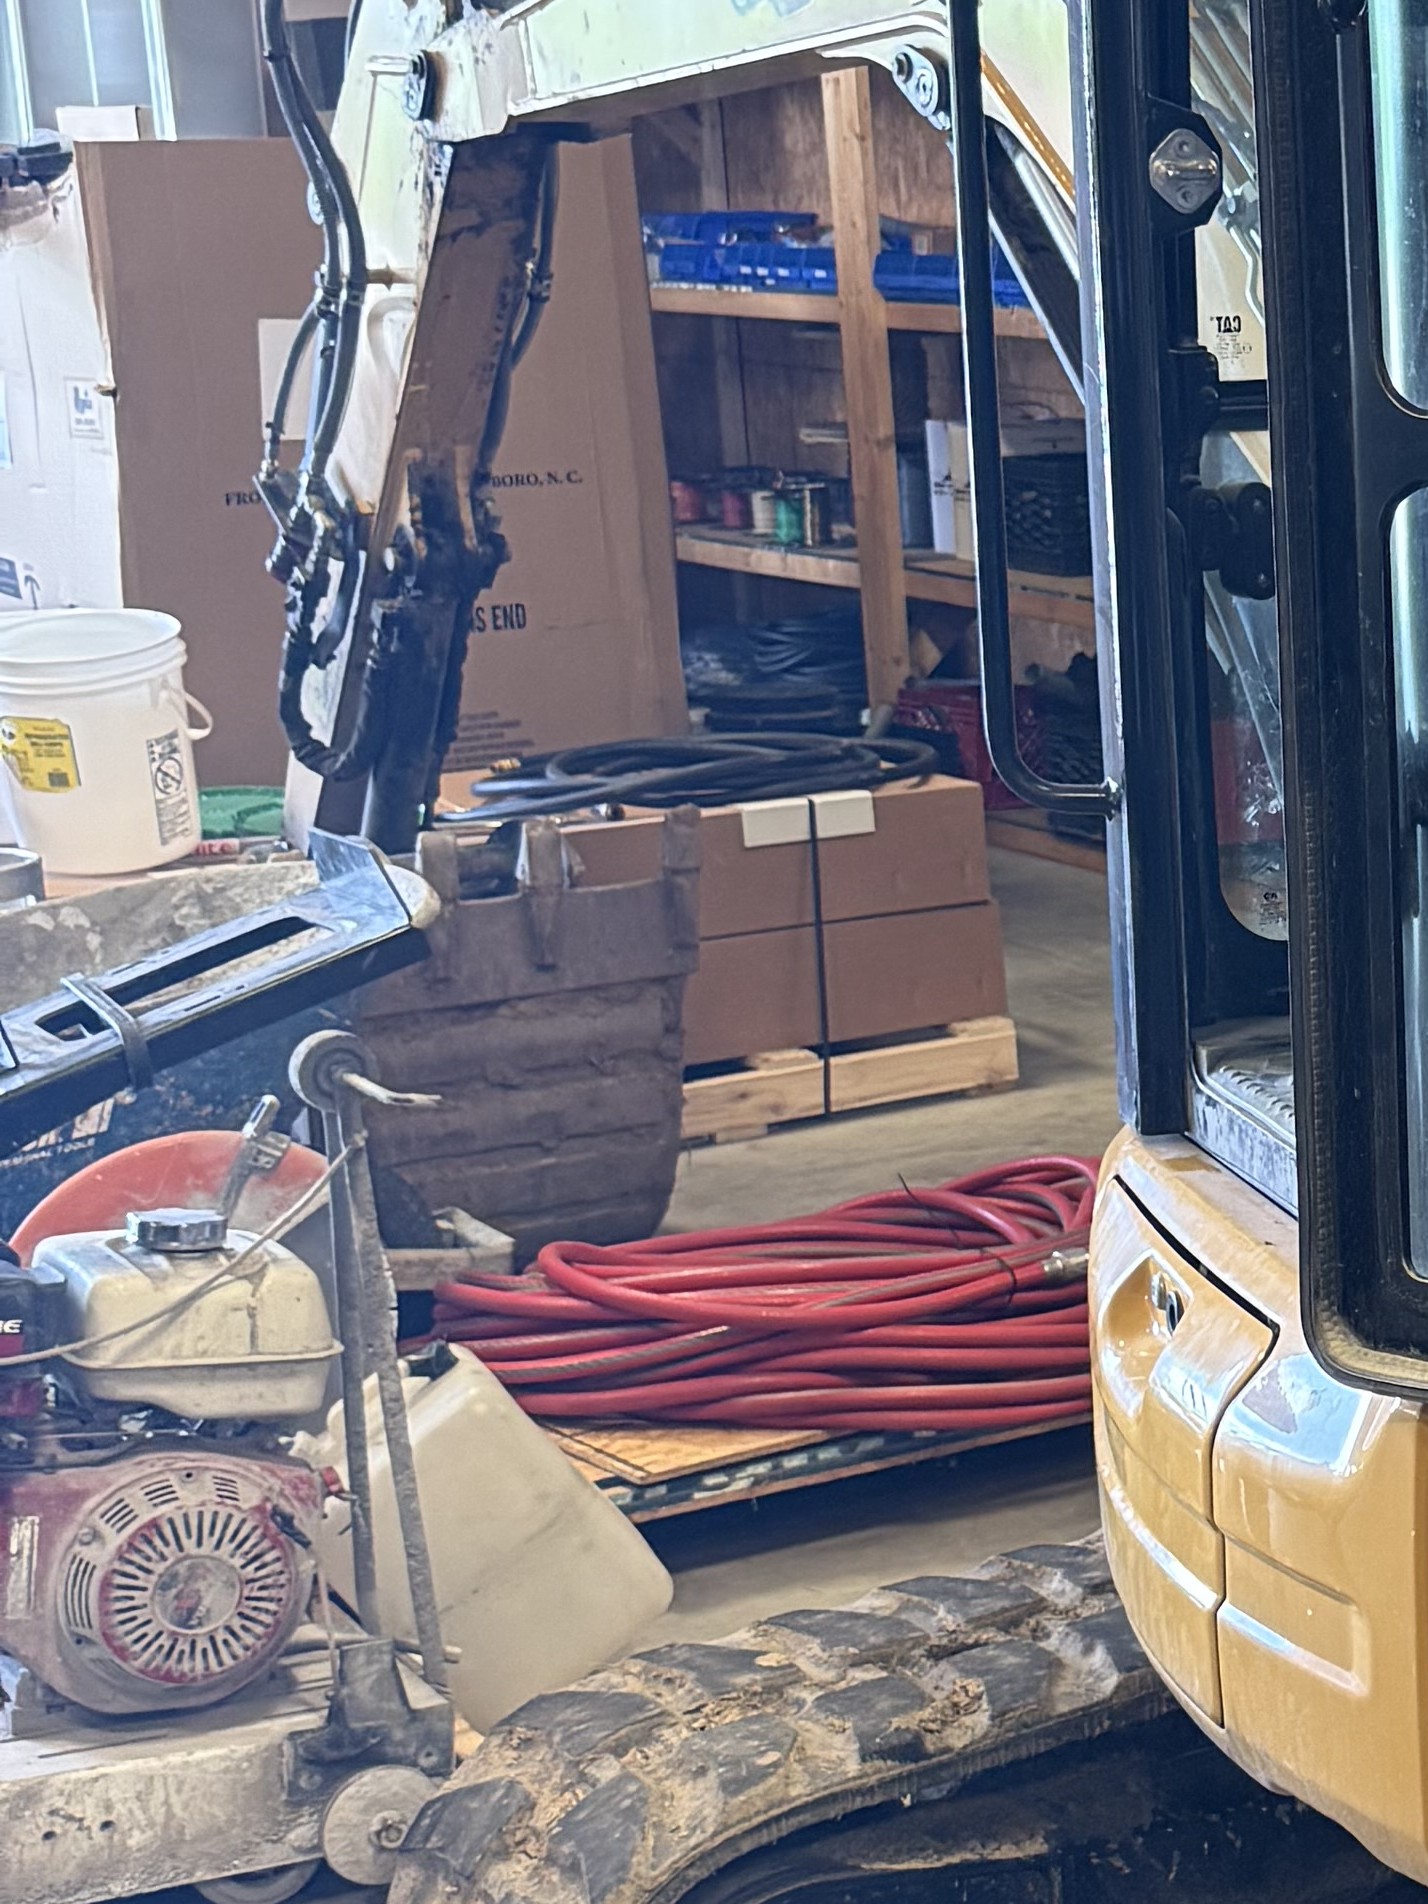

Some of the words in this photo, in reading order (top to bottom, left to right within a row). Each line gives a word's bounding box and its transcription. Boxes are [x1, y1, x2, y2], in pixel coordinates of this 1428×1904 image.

[225, 490, 262, 506] FRO
[491, 472, 544, 489] BORO,
[491, 601, 528, 631] END
